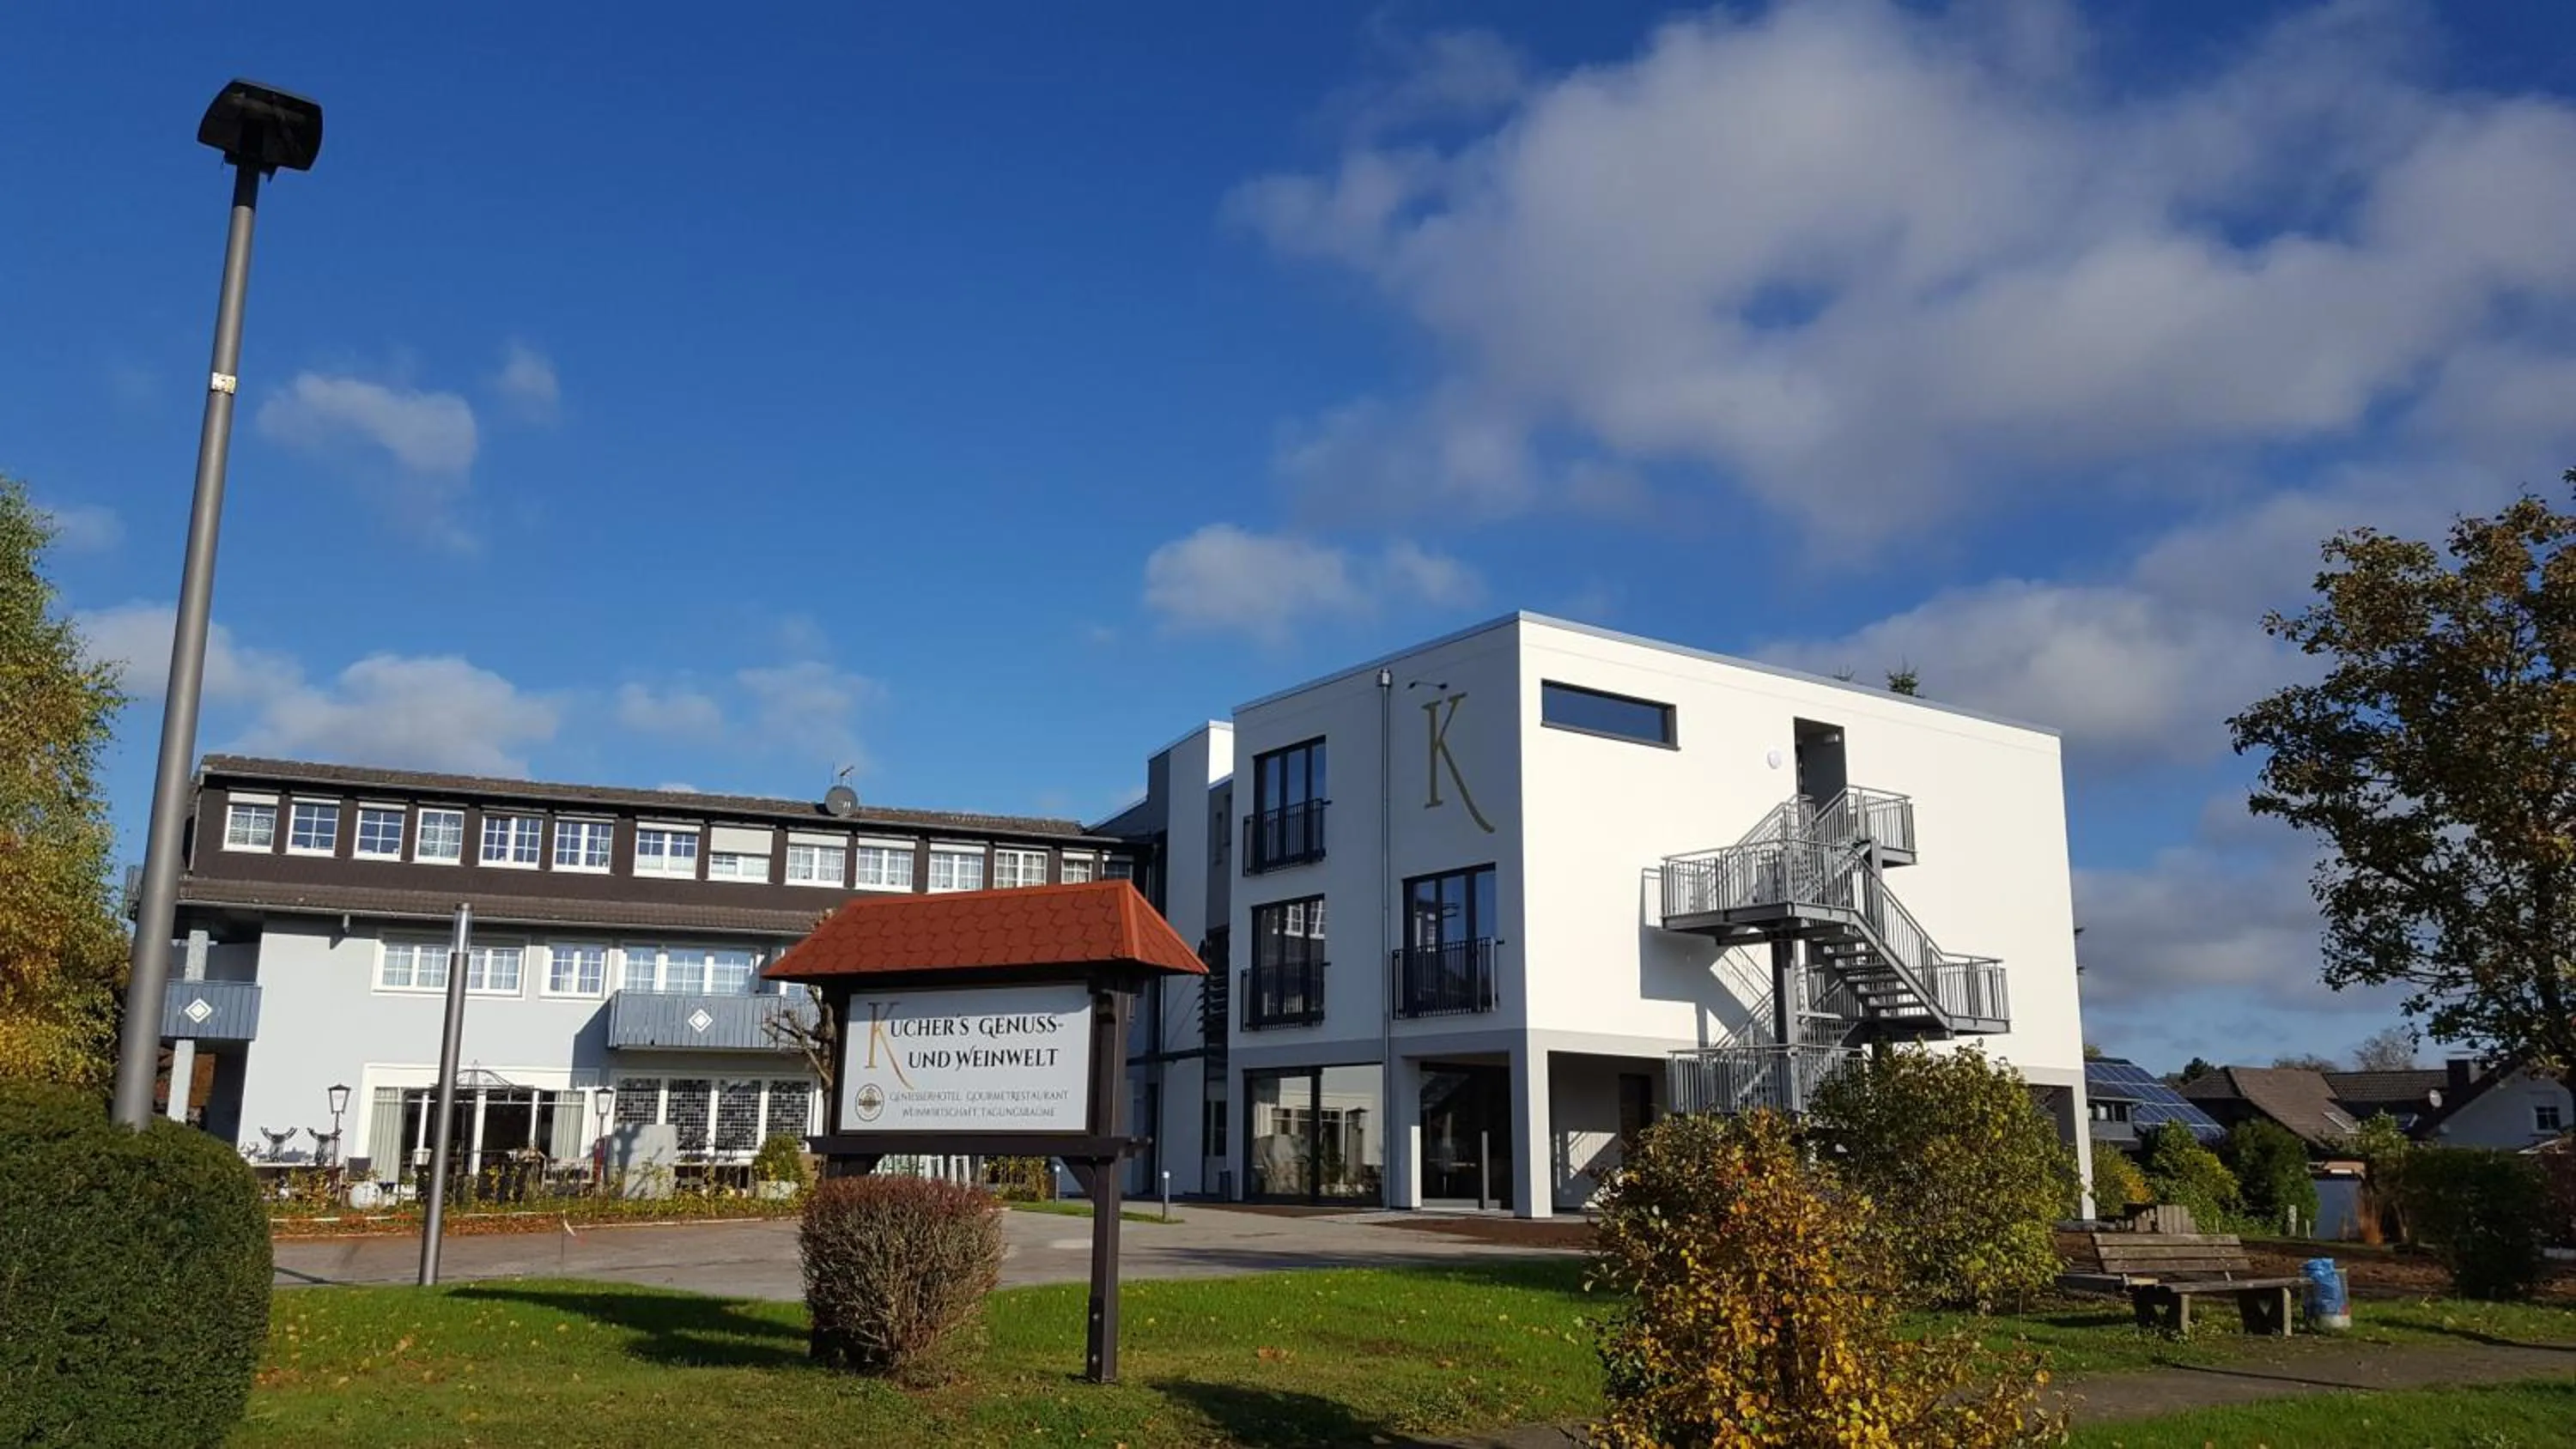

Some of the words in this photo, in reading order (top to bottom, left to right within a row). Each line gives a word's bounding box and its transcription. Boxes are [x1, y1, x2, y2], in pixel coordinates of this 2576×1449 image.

[1421, 692, 1495, 834] K
[979, 1015, 1064, 1039] GENUSS-
[908, 1050, 951, 1069] UND
[955, 1045, 1059, 1071] WEINWELT
